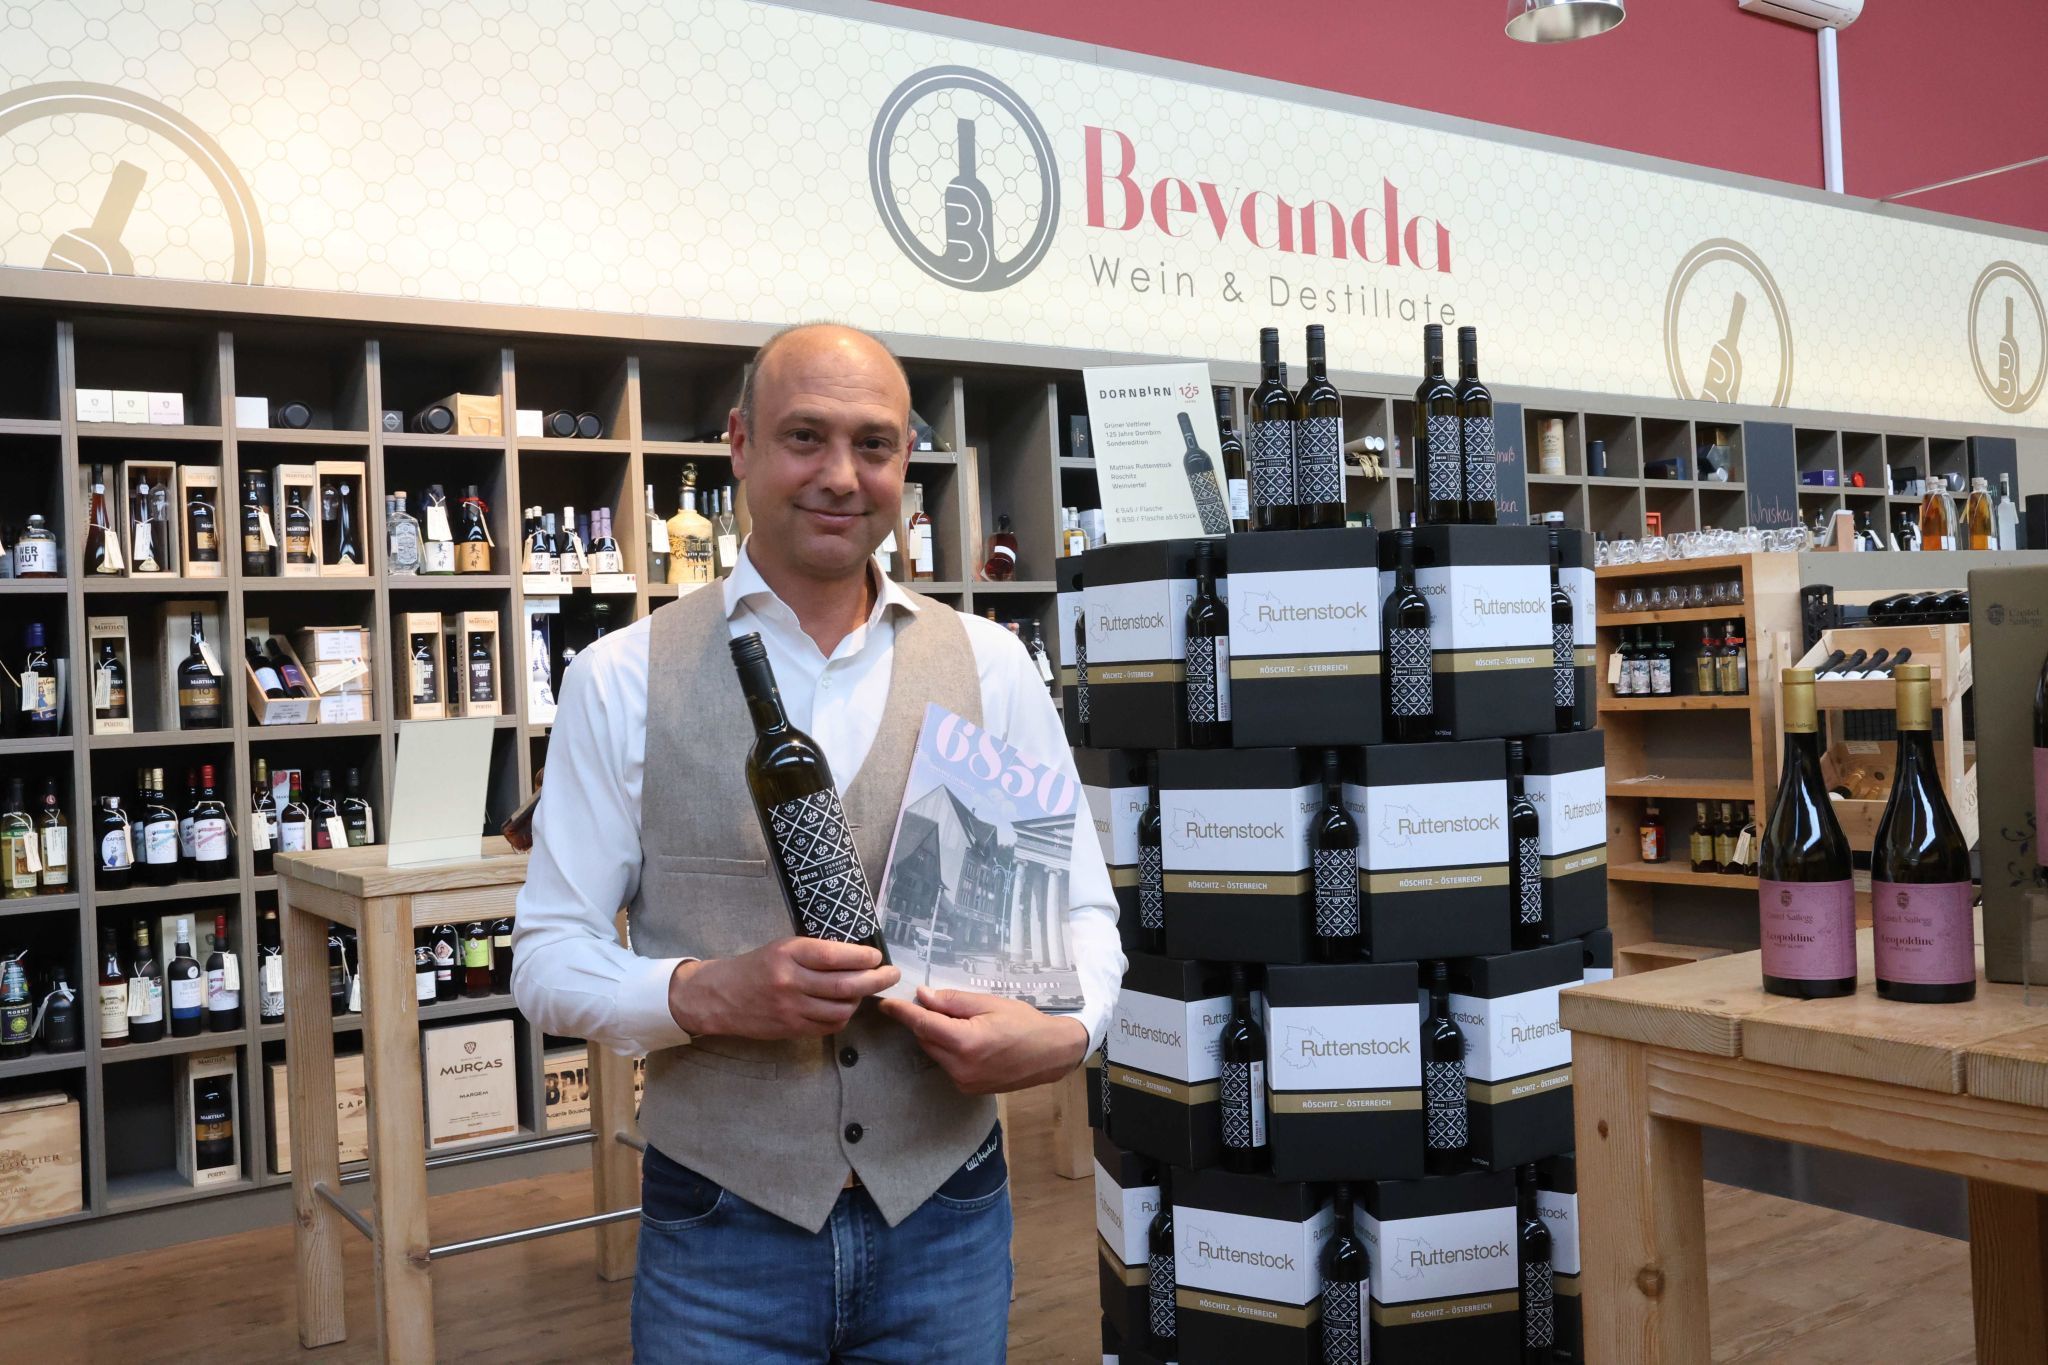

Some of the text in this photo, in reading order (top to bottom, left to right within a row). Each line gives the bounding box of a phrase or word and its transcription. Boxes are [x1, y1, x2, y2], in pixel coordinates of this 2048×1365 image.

[1083, 125, 1452, 274] Bevanda
[1089, 254, 1456, 326] Wein & Destillate
[1099, 383, 1200, 400] DORNBIRN 125
[1134, 428, 1162, 436] Dornbirn
[1106, 439, 1148, 447] Sonderedition
[1139, 504, 1163, 512] Flasche
[1258, 602, 1367, 622] Ruttenstock
[1474, 598, 1546, 615] Ruttenstock
[1100, 612, 1164, 632] Ruttenstock
[1260, 665, 1295, 674] RÖSCHITZ
[1304, 662, 1348, 672] ÖSTERREICH
[1475, 658, 1499, 666] RÖSCHITZ
[1506, 656, 1534, 665] ÖSTERREICH
[936, 714, 1074, 816] 6850
[803, 810, 818, 823] 125
[1564, 800, 1603, 821] Ruttenstock
[1186, 821, 1284, 839] Ruttenstock
[1399, 814, 1500, 835] Ruttenstock
[814, 844, 828, 855] 125
[826, 865, 847, 875] EDITION
[1227, 881, 1268, 890] ÖSTERREICH
[1400, 878, 1432, 888] RÖSCHITZ
[1441, 874, 1482, 885] ÖSTERREICH
[836, 910, 849, 921] 125
[1767, 931, 1815, 943] Leopoldine
[1881, 934, 1934, 946] Leopoldine
[1121, 1019, 1181, 1048] Ruttenstock
[1302, 1037, 1410, 1057] Ruttenstock
[440, 1059, 503, 1076] MURÇAS
[1511, 1082, 1536, 1095] RÖSCHITZ
[1541, 1074, 1568, 1088] ÖSTERREICH
[1302, 1100, 1338, 1109] RÖSCHITZ
[1347, 1098, 1391, 1108] ÖSTERREICH
[1198, 1242, 1294, 1271] Ruttenstock
[1410, 1241, 1509, 1267] Ruttenstock
[1200, 1300, 1230, 1311] RÖSCHITZ
[1237, 1305, 1278, 1319] ÖSTERREICH
[1411, 1309, 1444, 1320] RÖSCHITZ
[1451, 1303, 1492, 1314] ÖSTERREICH
